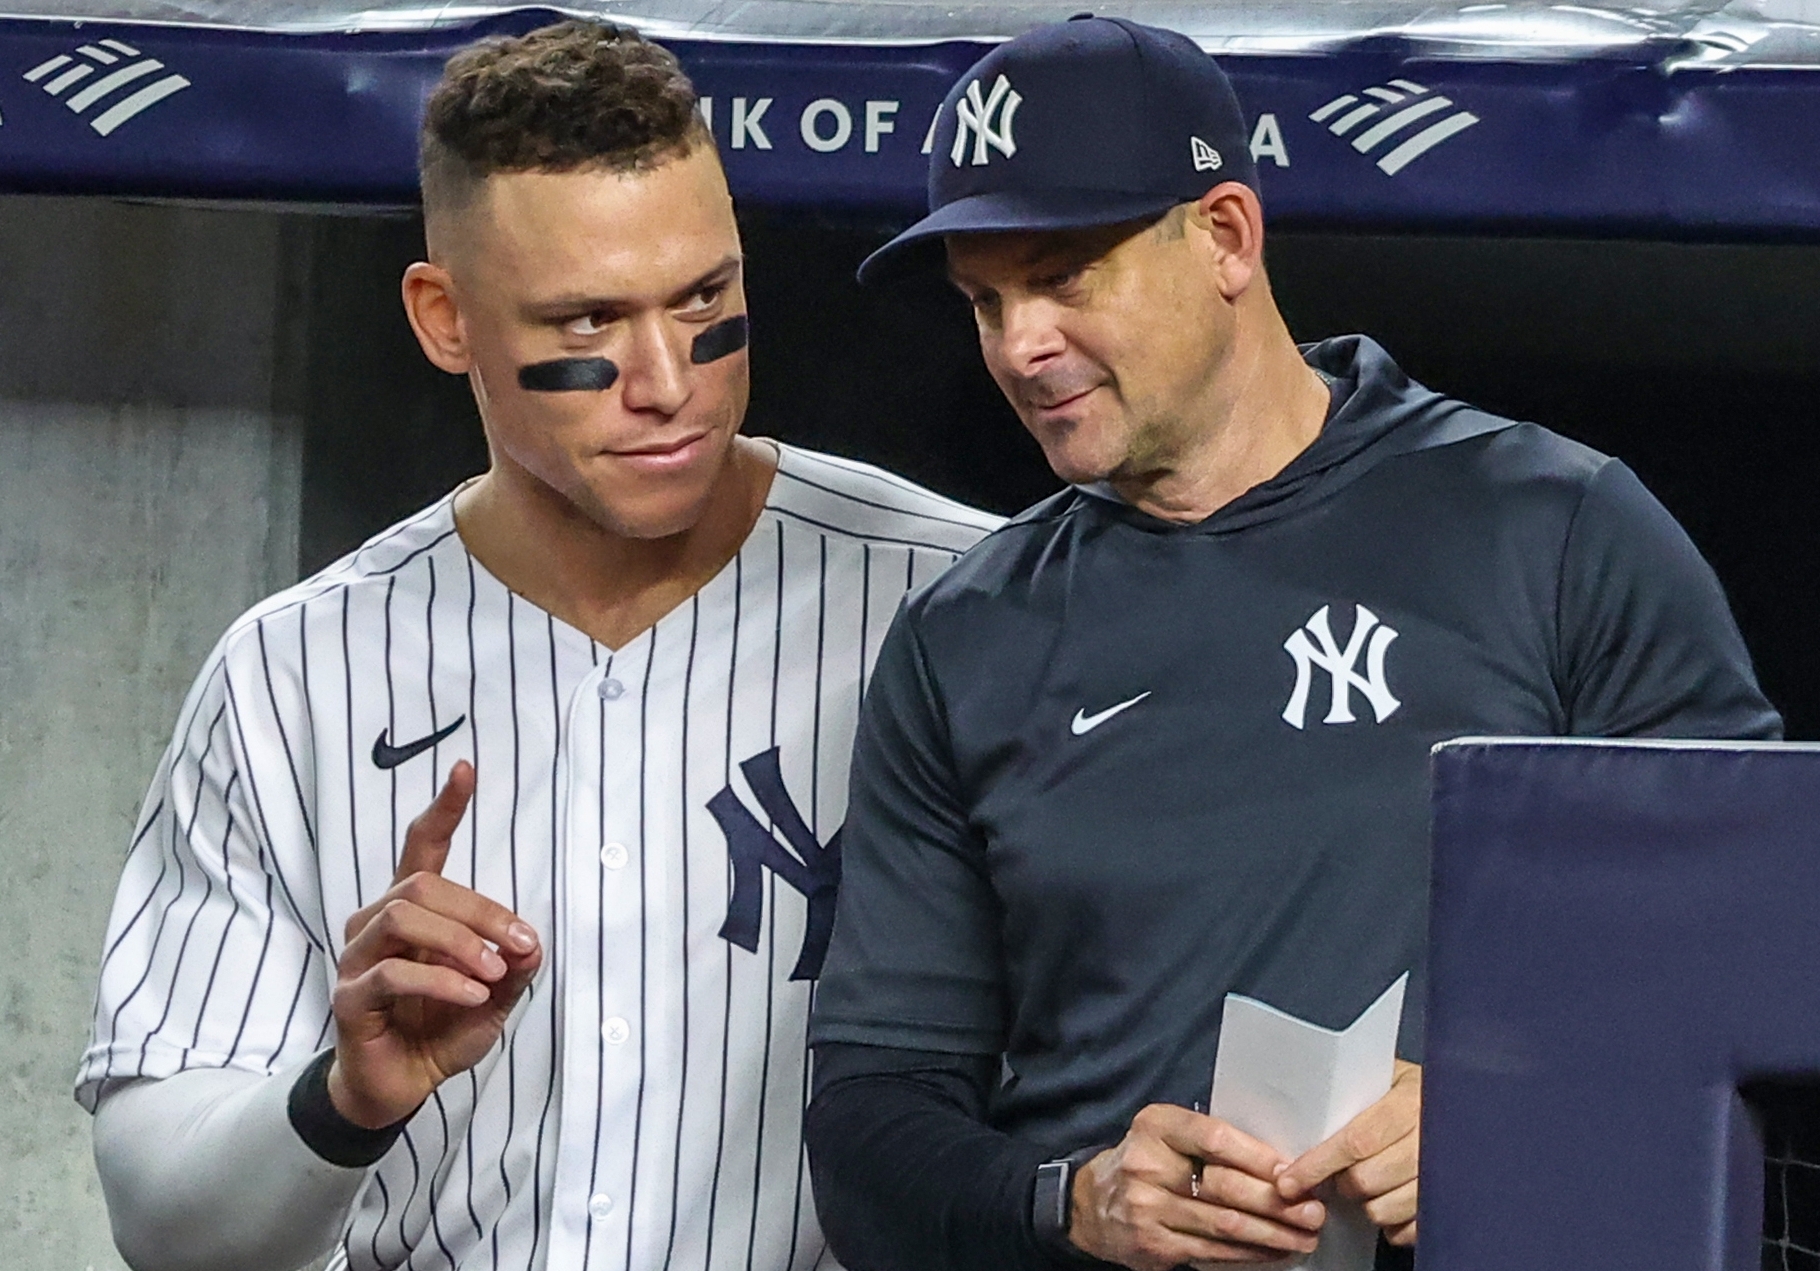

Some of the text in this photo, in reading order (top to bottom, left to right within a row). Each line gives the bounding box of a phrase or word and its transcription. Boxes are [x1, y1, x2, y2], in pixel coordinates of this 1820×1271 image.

[800, 98, 900, 153] OF
[950, 73, 1023, 168] NY
[1281, 603, 1402, 730] NY
